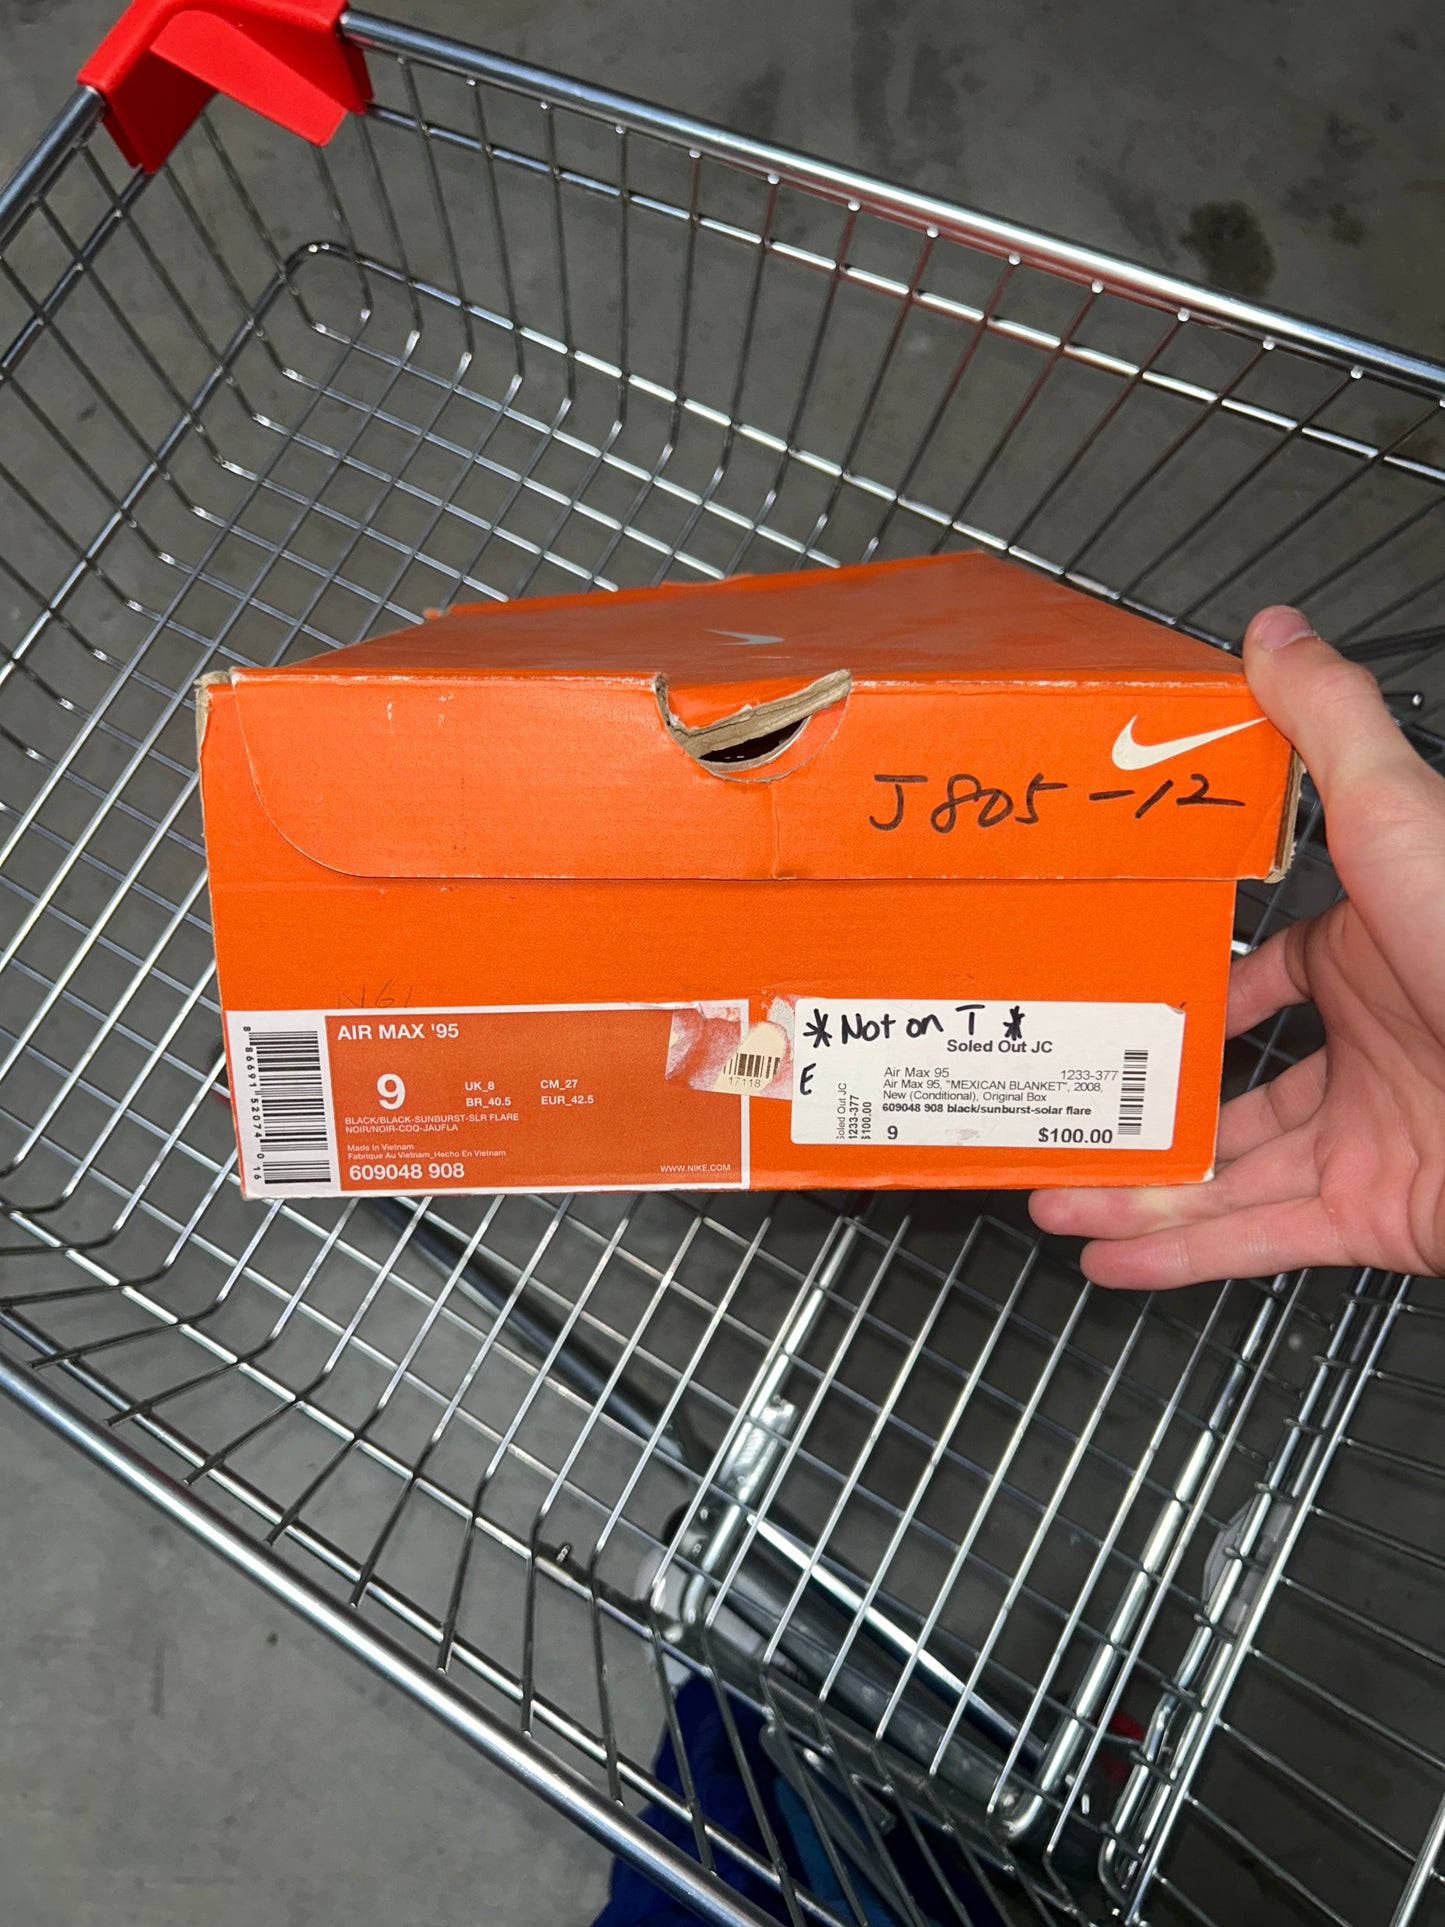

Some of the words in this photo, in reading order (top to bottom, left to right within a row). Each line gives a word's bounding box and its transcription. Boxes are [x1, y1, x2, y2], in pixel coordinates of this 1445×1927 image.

[337, 1024, 373, 1041] AIR
[379, 1023, 426, 1040] MAX
[430, 1022, 460, 1039] '95
[946, 1038, 994, 1054] Soled
[997, 1039, 1028, 1054] Out
[1030, 1040, 1054, 1054] JC
[245, 1046, 258, 1088] 86691
[883, 1066, 901, 1078] Air
[904, 1067, 930, 1078] Max
[933, 1067, 950, 1078] 95
[1060, 1069, 1119, 1081] 1233-377
[376, 1073, 407, 1110] 9
[837, 1082, 847, 1096] JC
[882, 1079, 899, 1089] Air
[900, 1079, 924, 1089] Max
[945, 1079, 1006, 1091] "MEXICAN
[882, 1091, 907, 1100] New
[982, 1091, 1024, 1103] Original
[1026, 1092, 1047, 1102] Box
[836, 1098, 846, 1114] Out
[882, 1103, 921, 1113] 609048
[923, 1103, 944, 1113] 908
[946, 1103, 1063, 1116] black/sunburst-solar
[1065, 1105, 1092, 1116] flare
[250, 1097, 263, 1139] 52074
[489, 1113, 520, 1122] FLARE
[848, 1094, 860, 1140] 1233-377
[887, 1125, 899, 1140] 9
[1037, 1127, 1114, 1144] $100.00
[347, 1144, 370, 1152] Made
[381, 1143, 415, 1151] Vietnam
[348, 1152, 384, 1161] Fabrique
[385, 1152, 397, 1160] Au
[461, 1150, 473, 1158] En
[474, 1149, 507, 1157] Vietnam
[349, 1164, 424, 1181] 609048
[427, 1162, 466, 1179] 908
[660, 1163, 731, 1173] WWW.NIKE.COM
